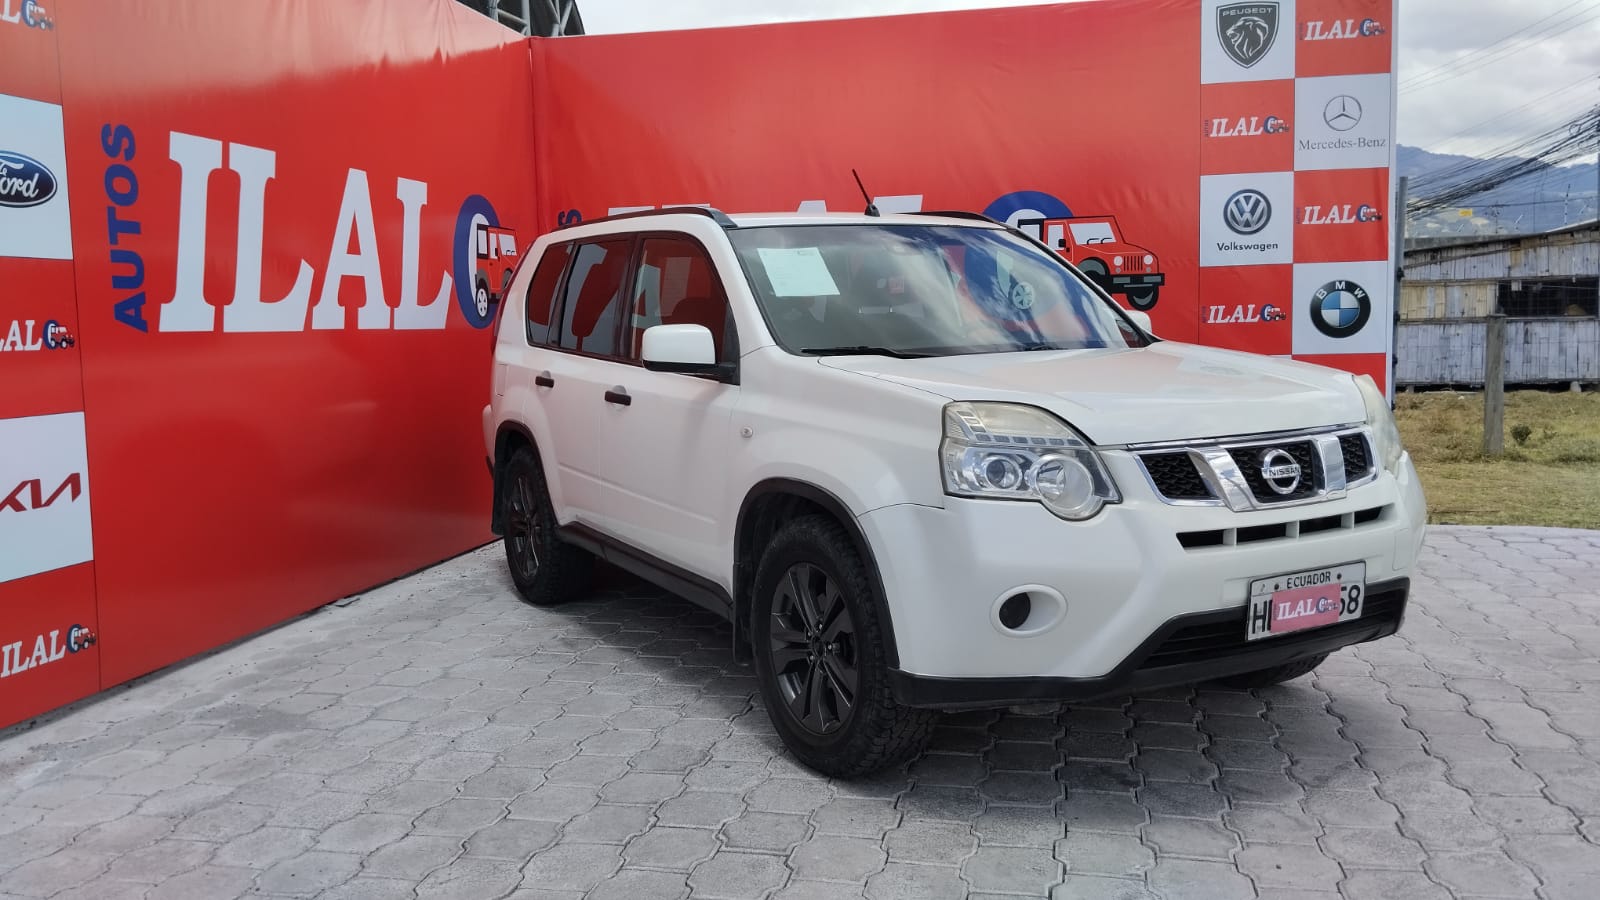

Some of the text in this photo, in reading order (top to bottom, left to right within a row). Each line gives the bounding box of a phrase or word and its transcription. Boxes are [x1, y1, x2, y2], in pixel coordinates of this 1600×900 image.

[1222, 7, 1273, 17] PEUGEOT
[1299, 137, 1386, 150] Mercedes-Benz
[101, 123, 149, 333] AUTOS
[1216, 241, 1279, 252] Volkswagen
[1315, 280, 1366, 300] BMW
[1268, 465, 1301, 478] NISSAN
[1286, 570, 1332, 589] ECUADOR
